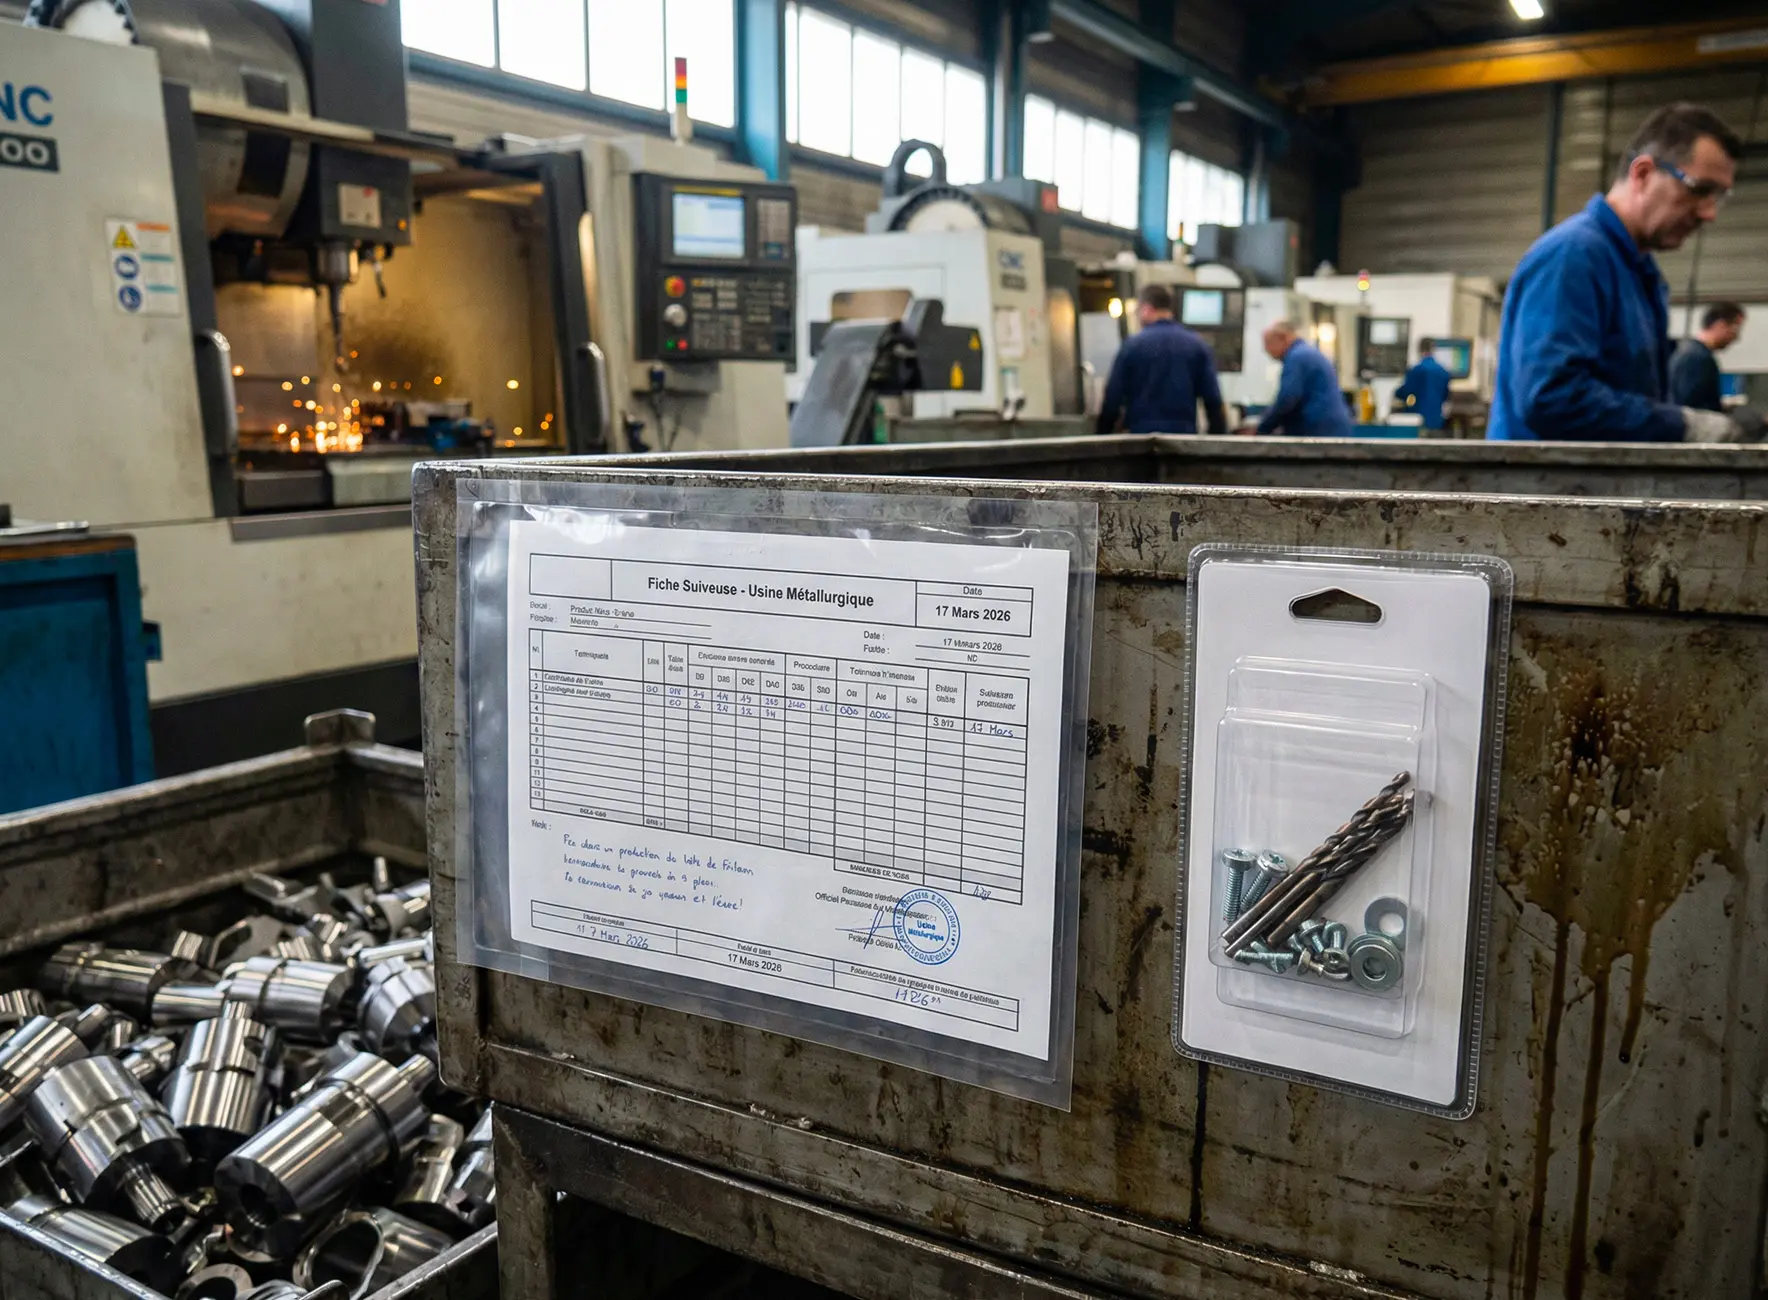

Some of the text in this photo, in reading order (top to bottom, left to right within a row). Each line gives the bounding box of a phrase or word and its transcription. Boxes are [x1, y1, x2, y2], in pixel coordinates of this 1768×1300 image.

[648, 577, 680, 592] Fiche
[683, 580, 738, 596] Suiveuse
[749, 584, 784, 599] Usine
[787, 586, 874, 609] Métallurgique
[963, 586, 982, 596] Date
[936, 605, 1011, 622] 17 Mars 2026
[864, 631, 881, 640] Date
[728, 953, 783, 972] 17 Mars 2026
